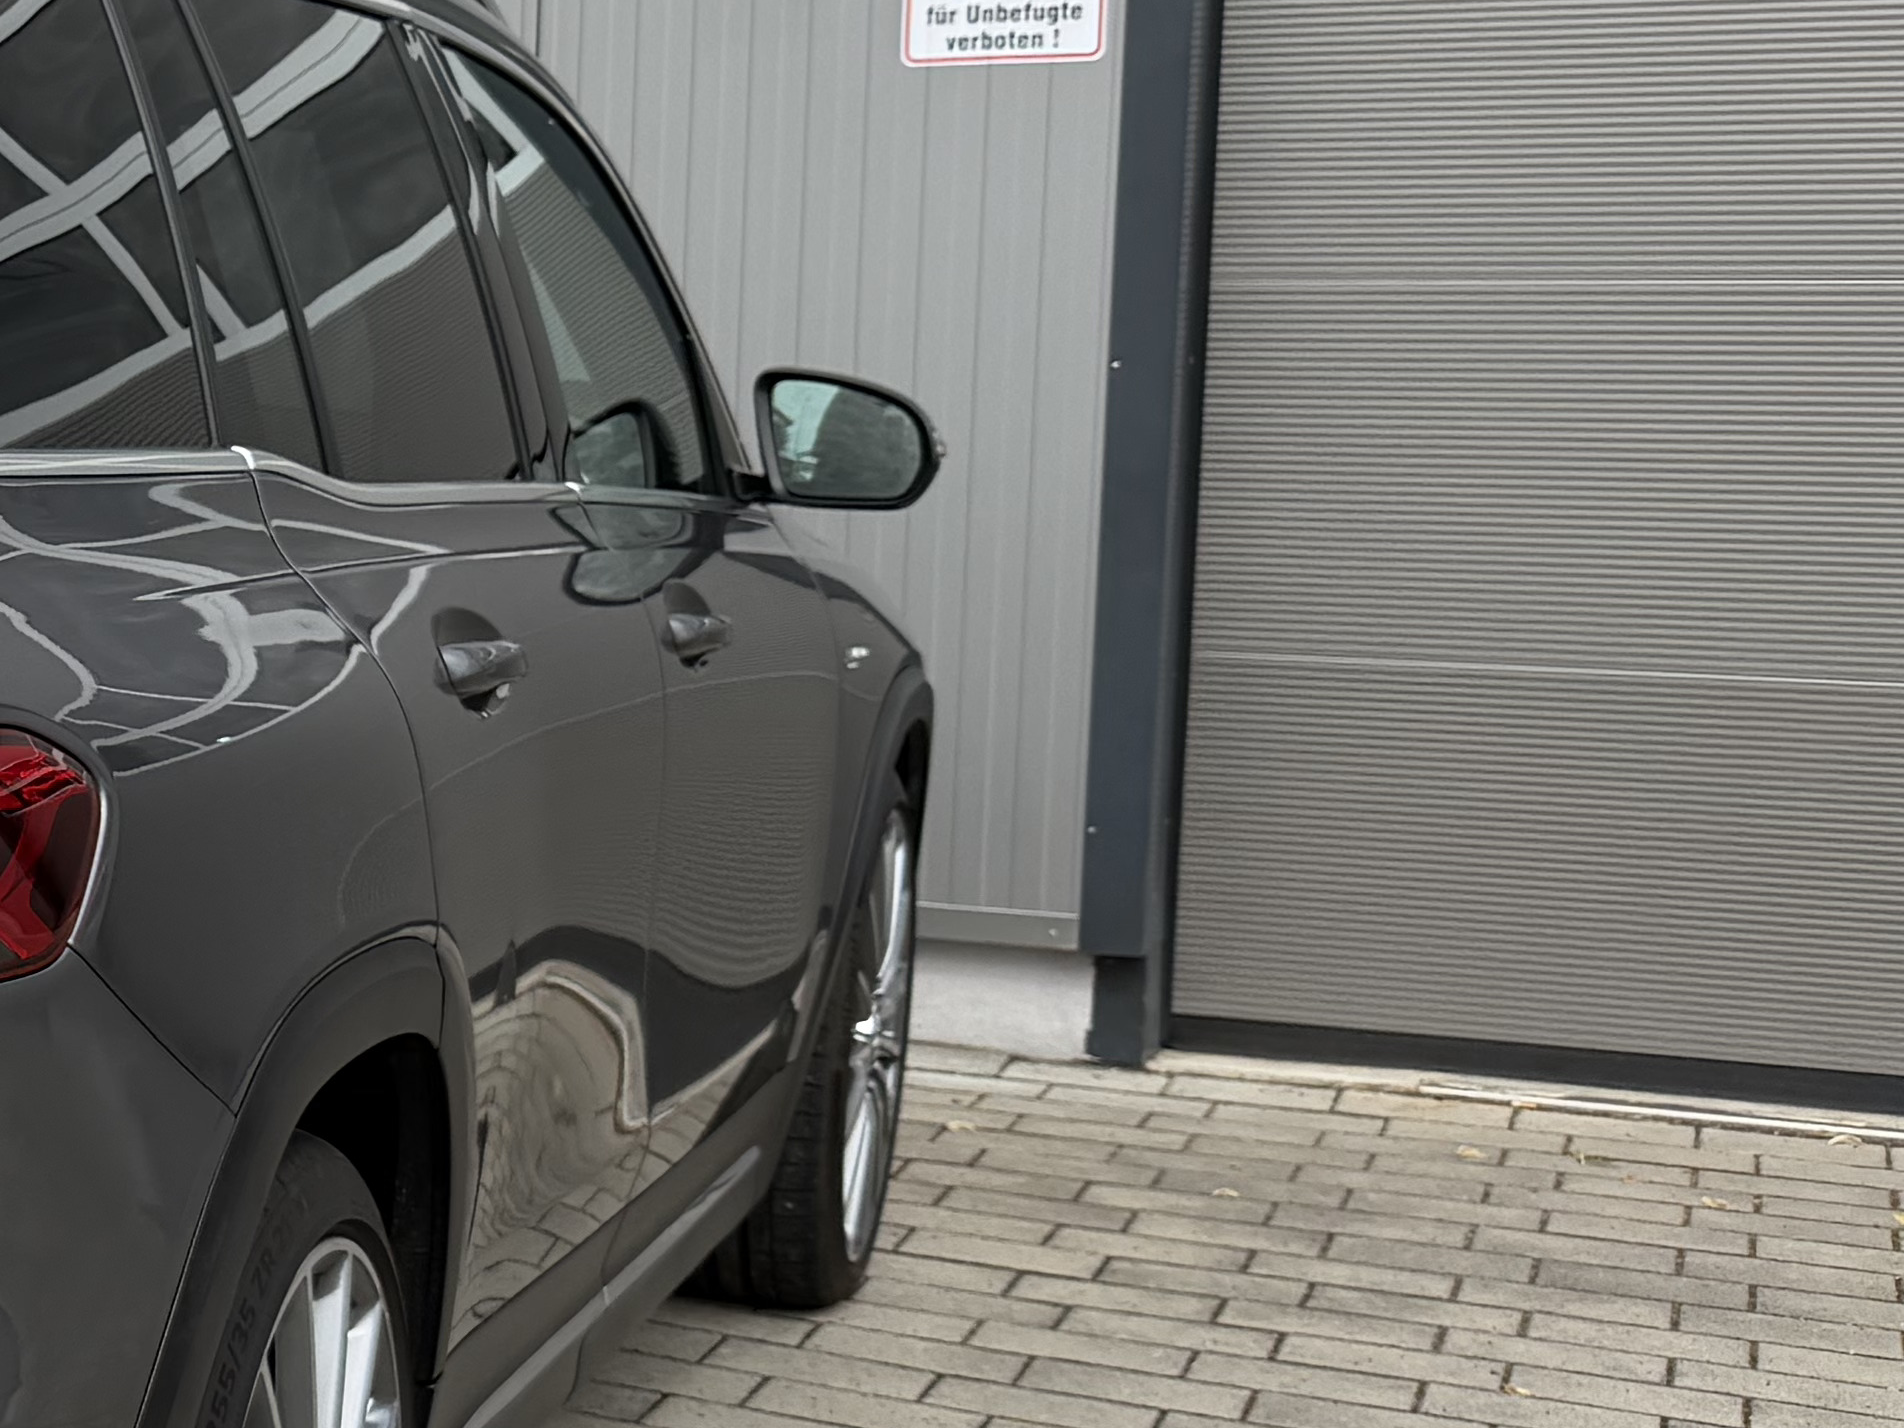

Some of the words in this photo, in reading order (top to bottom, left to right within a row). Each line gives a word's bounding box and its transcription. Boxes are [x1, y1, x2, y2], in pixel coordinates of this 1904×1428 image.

[927, 6, 957, 25] für
[966, 2, 1083, 25] Unbefugte
[946, 30, 1043, 51] verboten
